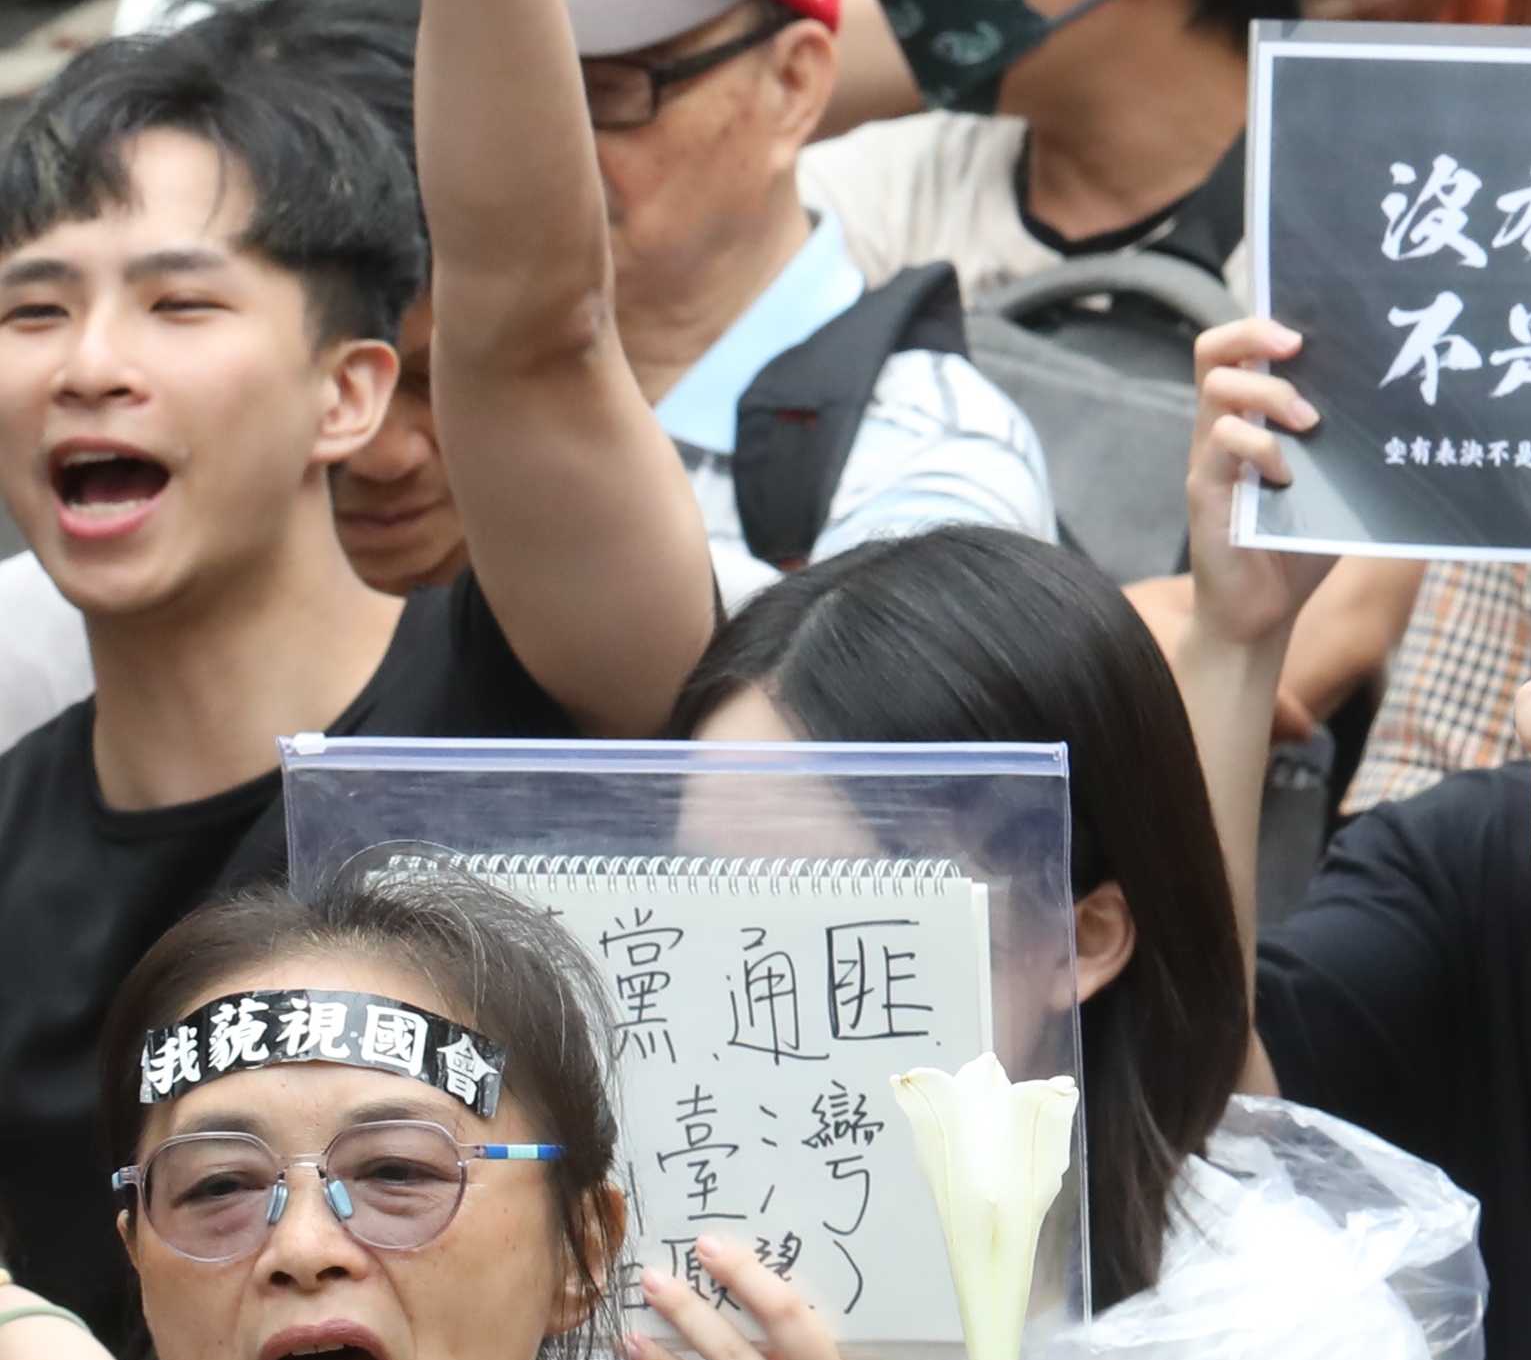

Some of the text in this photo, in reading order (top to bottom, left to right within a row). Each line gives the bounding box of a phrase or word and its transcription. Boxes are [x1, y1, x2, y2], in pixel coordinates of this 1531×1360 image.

[145, 997, 500, 1106] 我藐視國會
